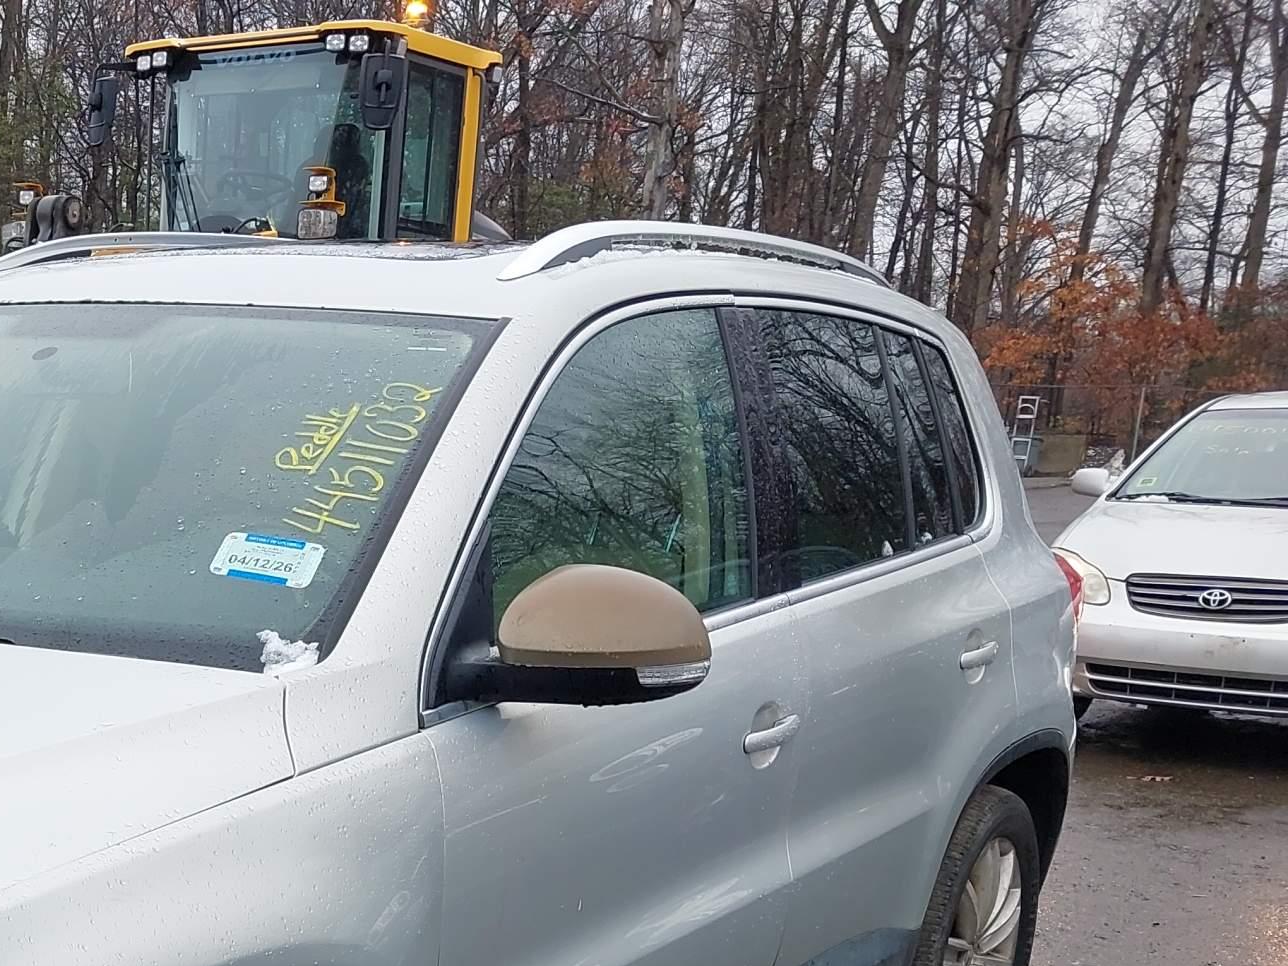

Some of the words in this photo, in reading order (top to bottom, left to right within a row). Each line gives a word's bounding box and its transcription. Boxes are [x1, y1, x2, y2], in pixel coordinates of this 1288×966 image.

[216, 50, 296, 68] VOLVO
[282, 382, 443, 534] 44511032
[228, 554, 294, 573] 04/12/26
